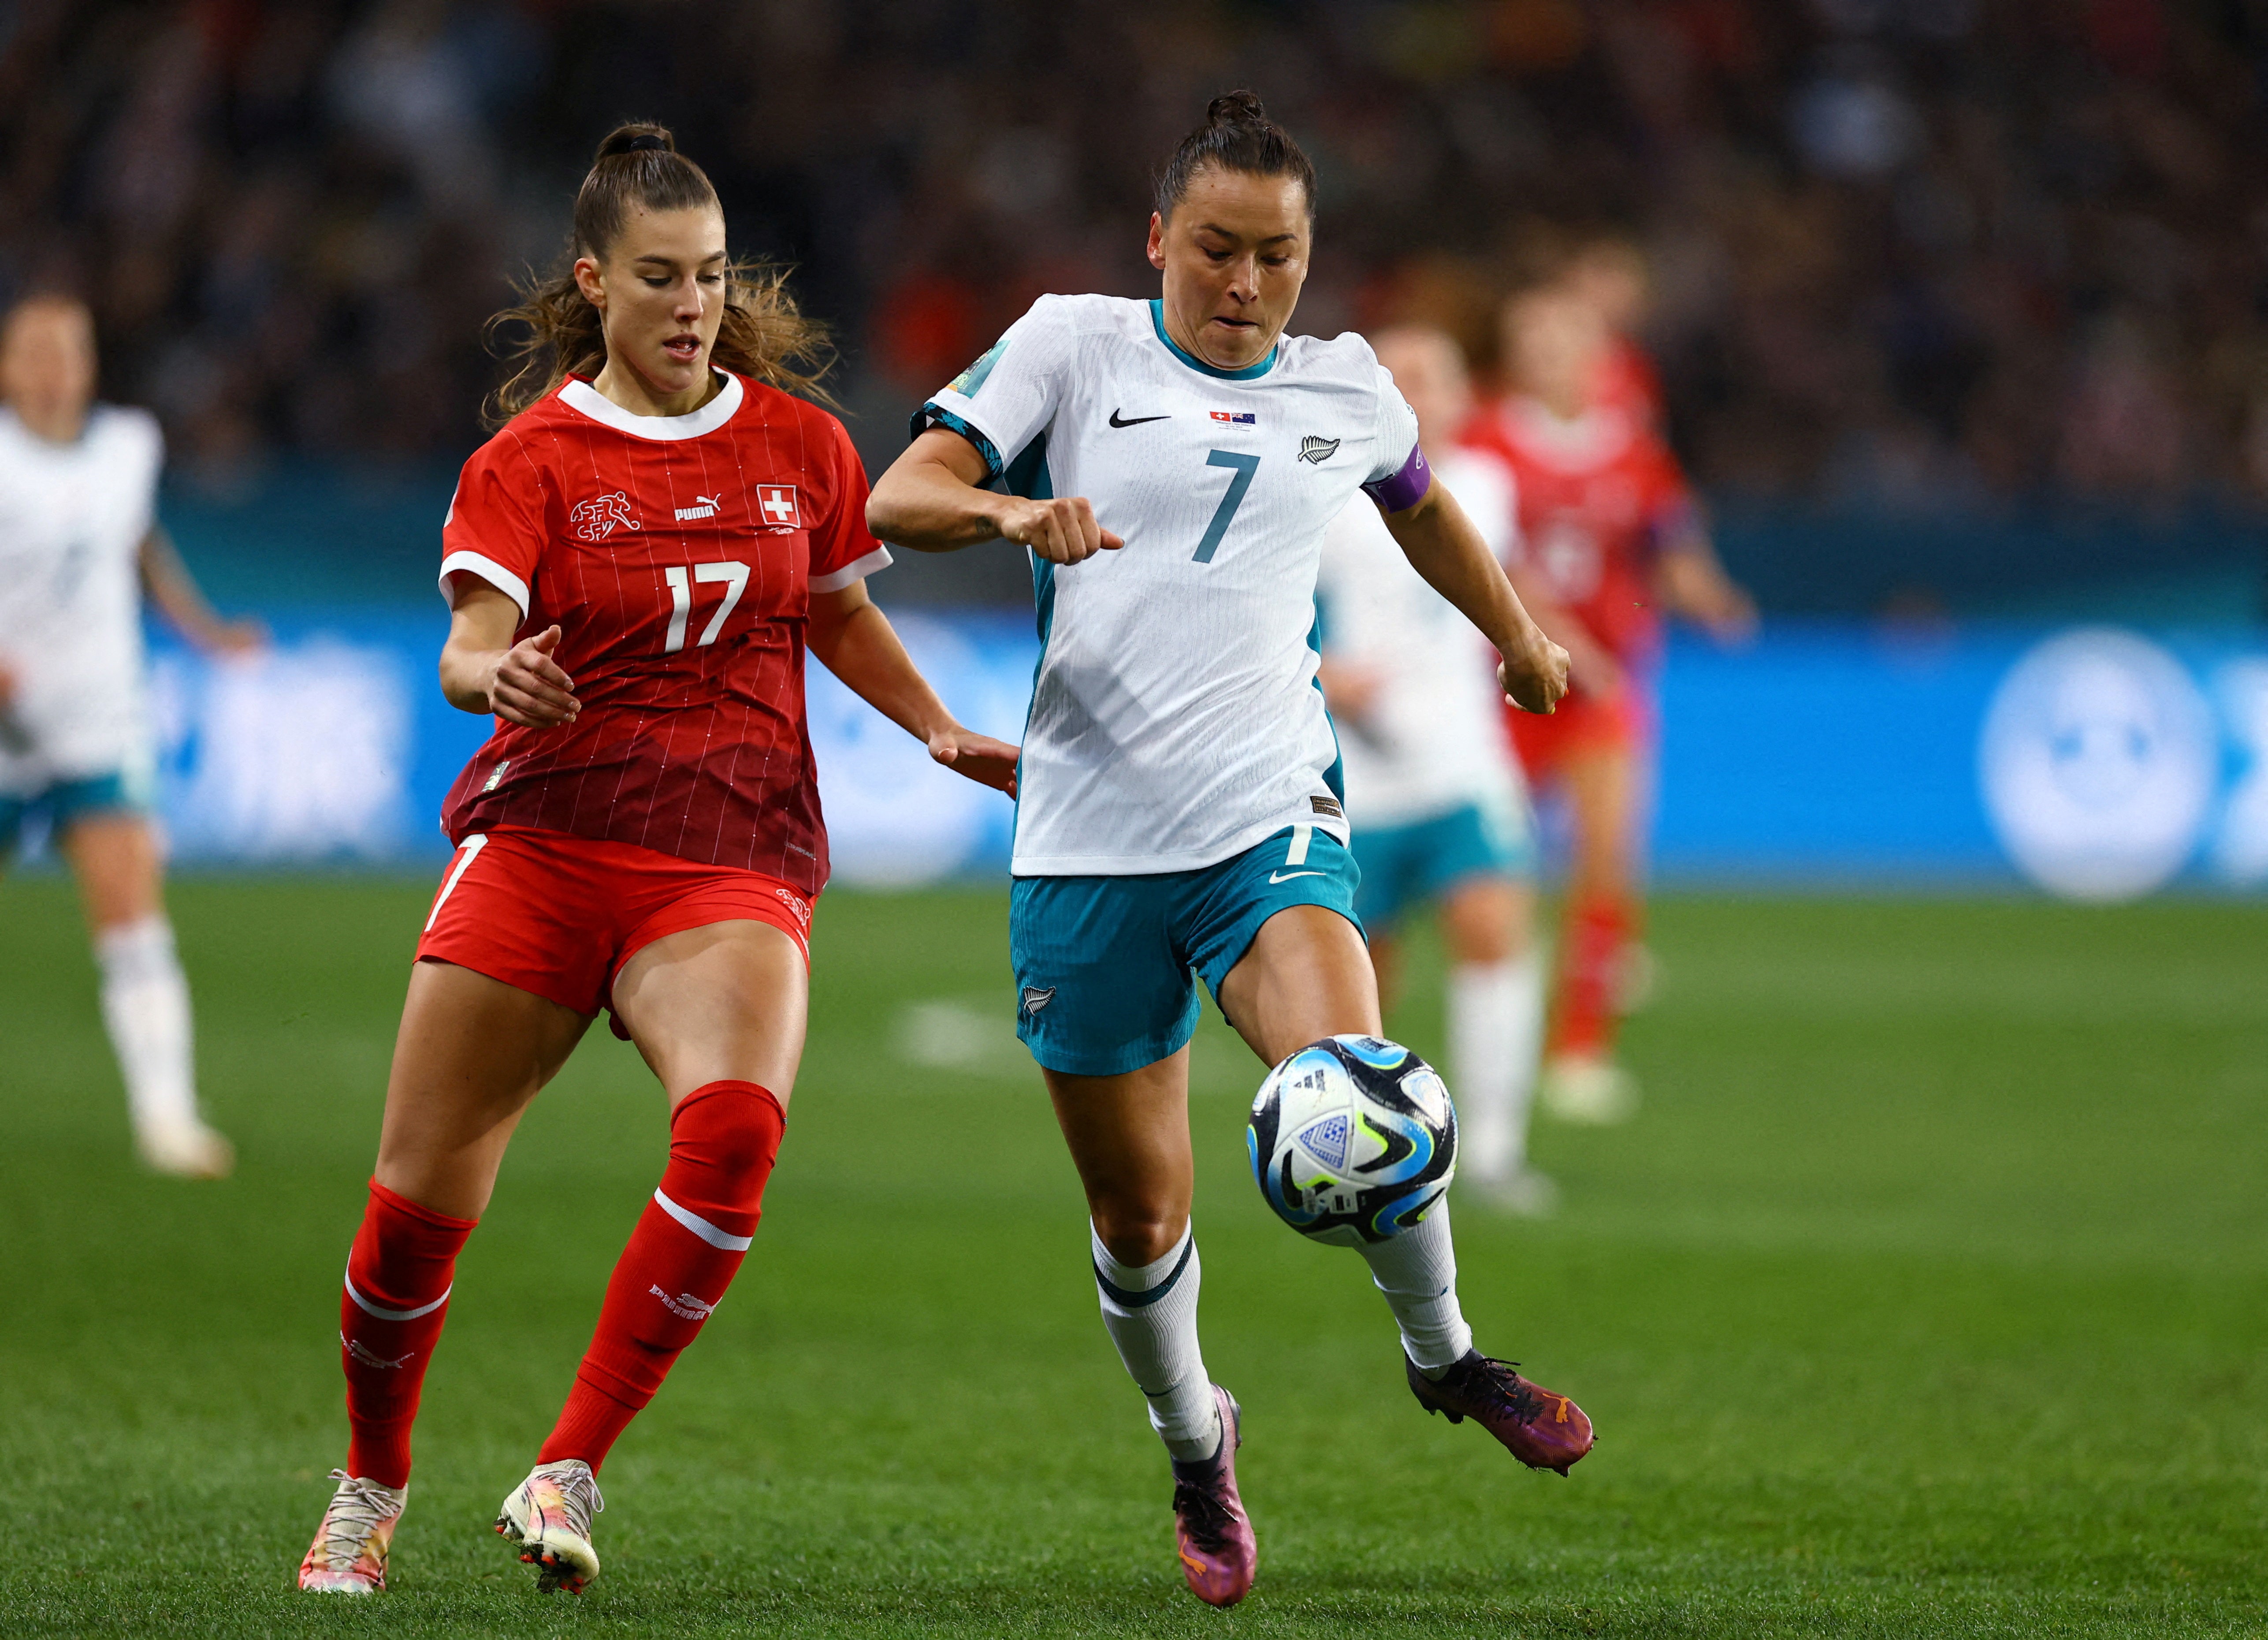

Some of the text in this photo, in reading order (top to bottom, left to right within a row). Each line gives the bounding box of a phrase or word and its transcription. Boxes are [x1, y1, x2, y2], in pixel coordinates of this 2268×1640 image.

[674, 505, 714, 521] PUMA
[1192, 449, 1261, 564] 7
[665, 561, 751, 653] 17
